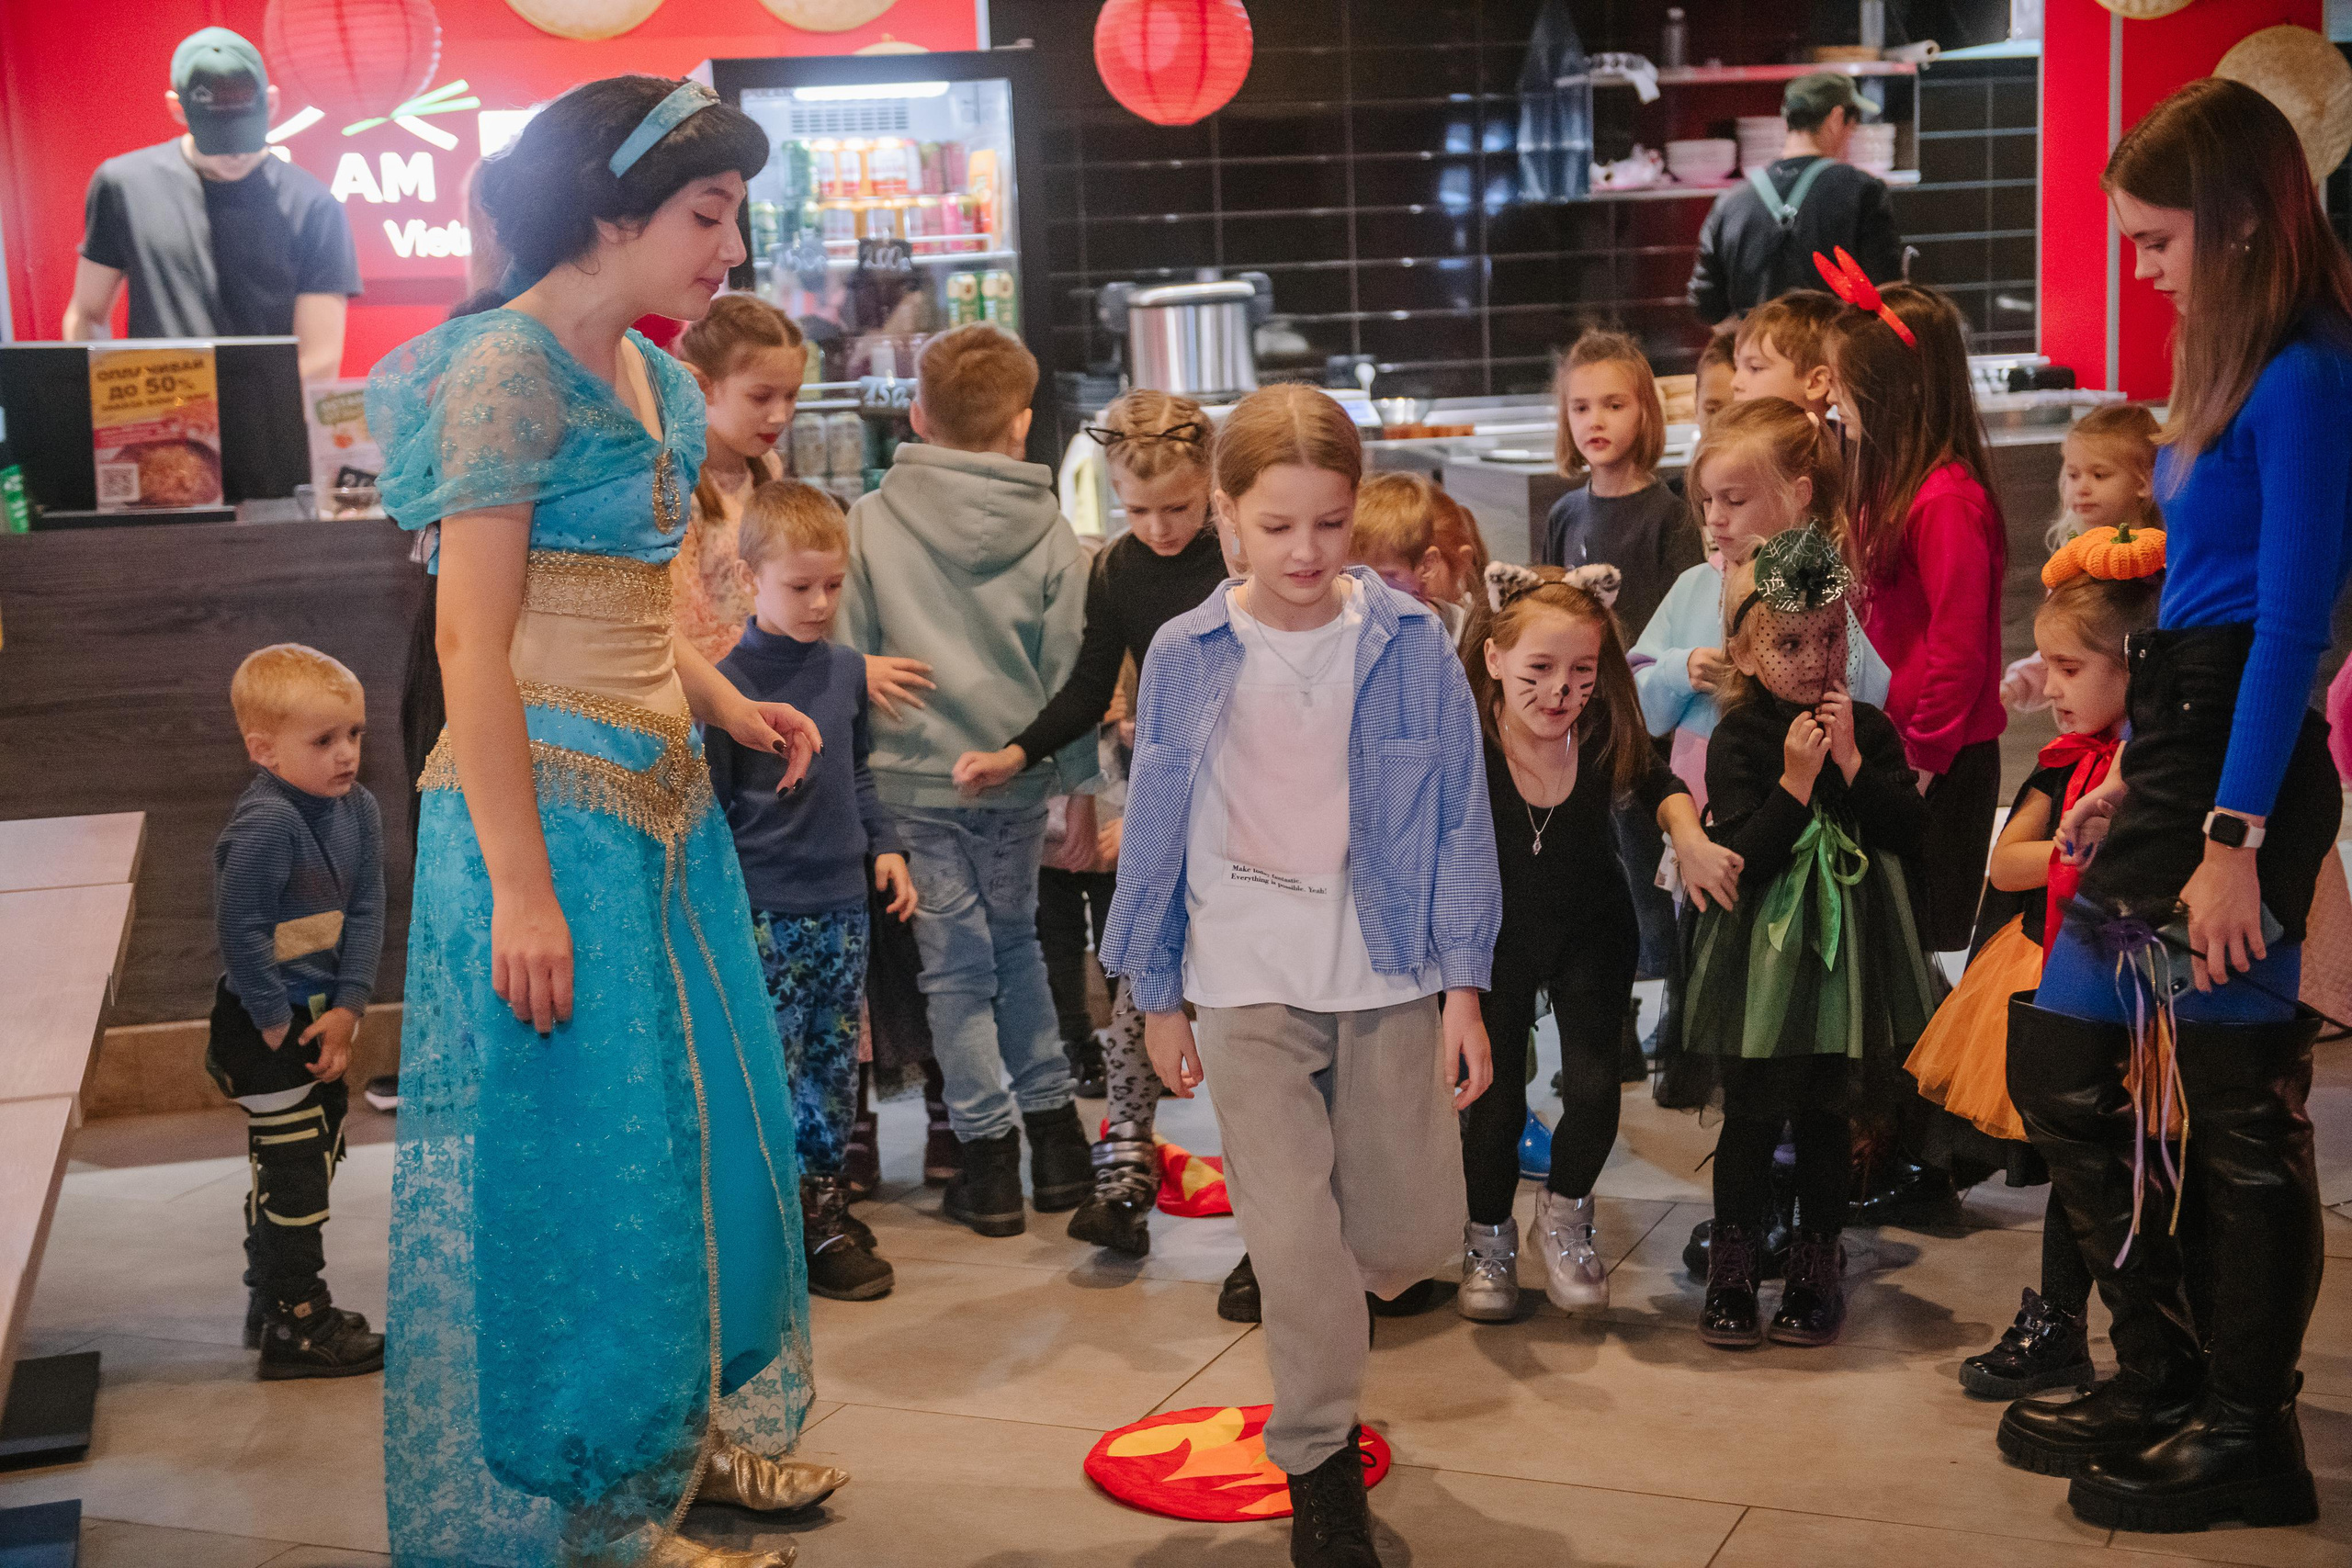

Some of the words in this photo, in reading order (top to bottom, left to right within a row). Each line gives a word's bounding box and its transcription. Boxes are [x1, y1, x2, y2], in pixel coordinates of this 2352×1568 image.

[1231, 864, 1251, 873] Make
[1272, 874, 1302, 885] fantastic.
[1231, 873, 1269, 885] Everything
[1278, 882, 1306, 892] possible.
[1307, 886, 1328, 895] Yeah!
